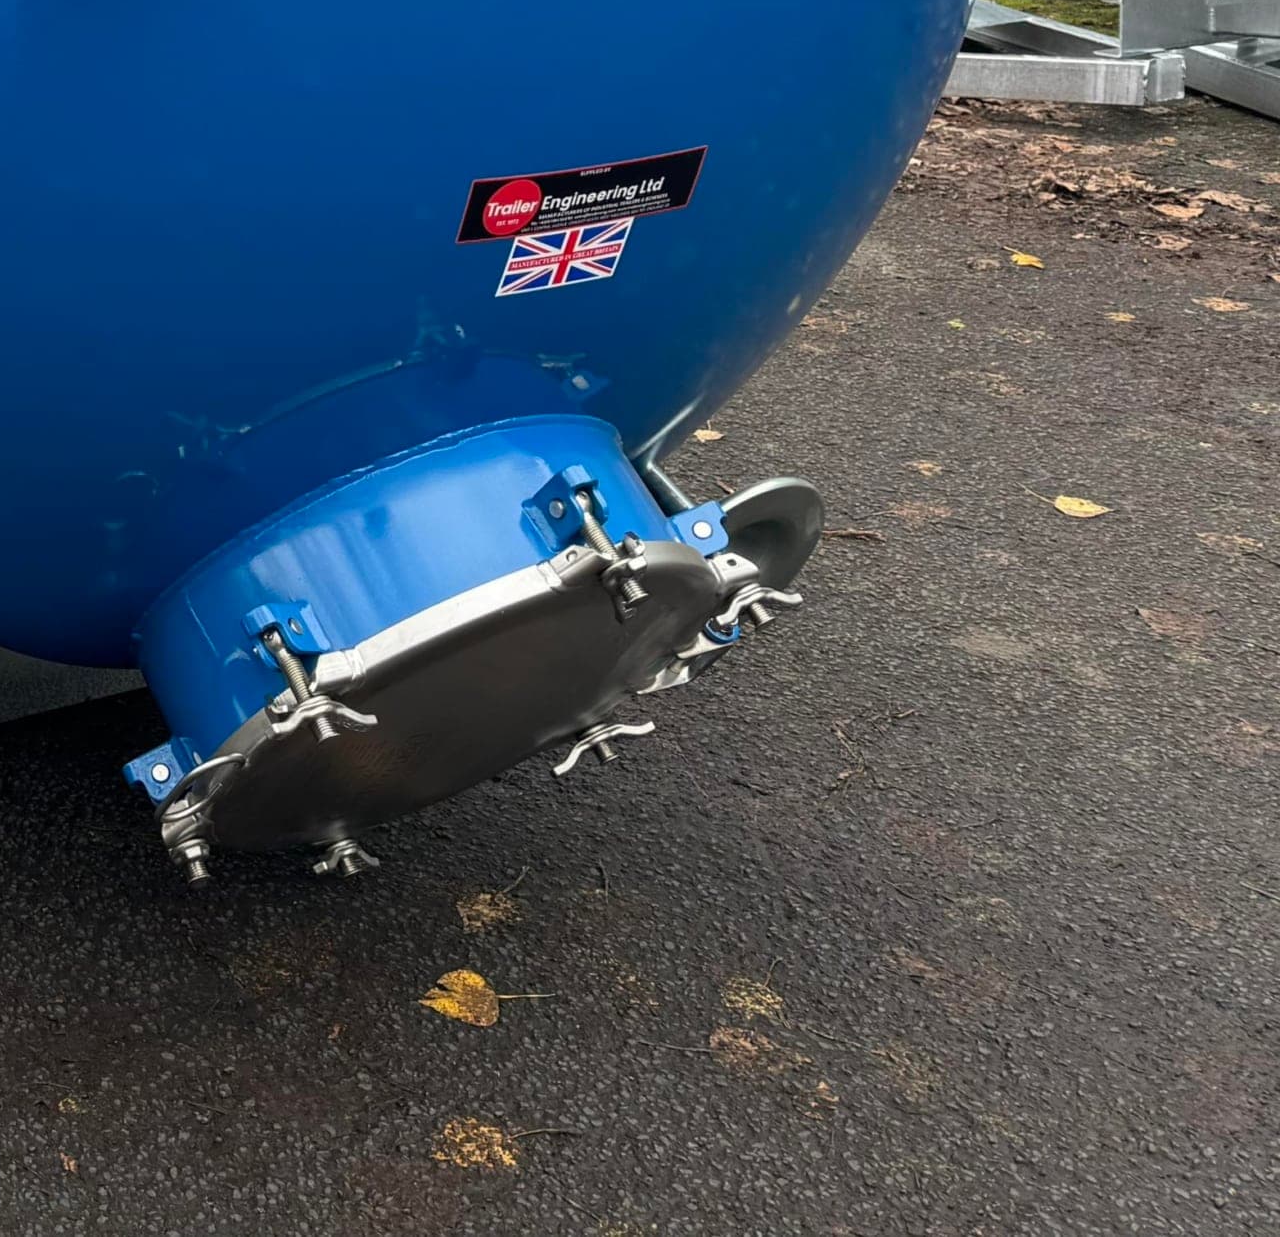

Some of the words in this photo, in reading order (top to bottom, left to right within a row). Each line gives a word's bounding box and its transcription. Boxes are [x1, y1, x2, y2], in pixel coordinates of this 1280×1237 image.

[487, 199, 539, 218] Trailer
[541, 184, 639, 212] Engineering
[639, 176, 665, 195] Ltd
